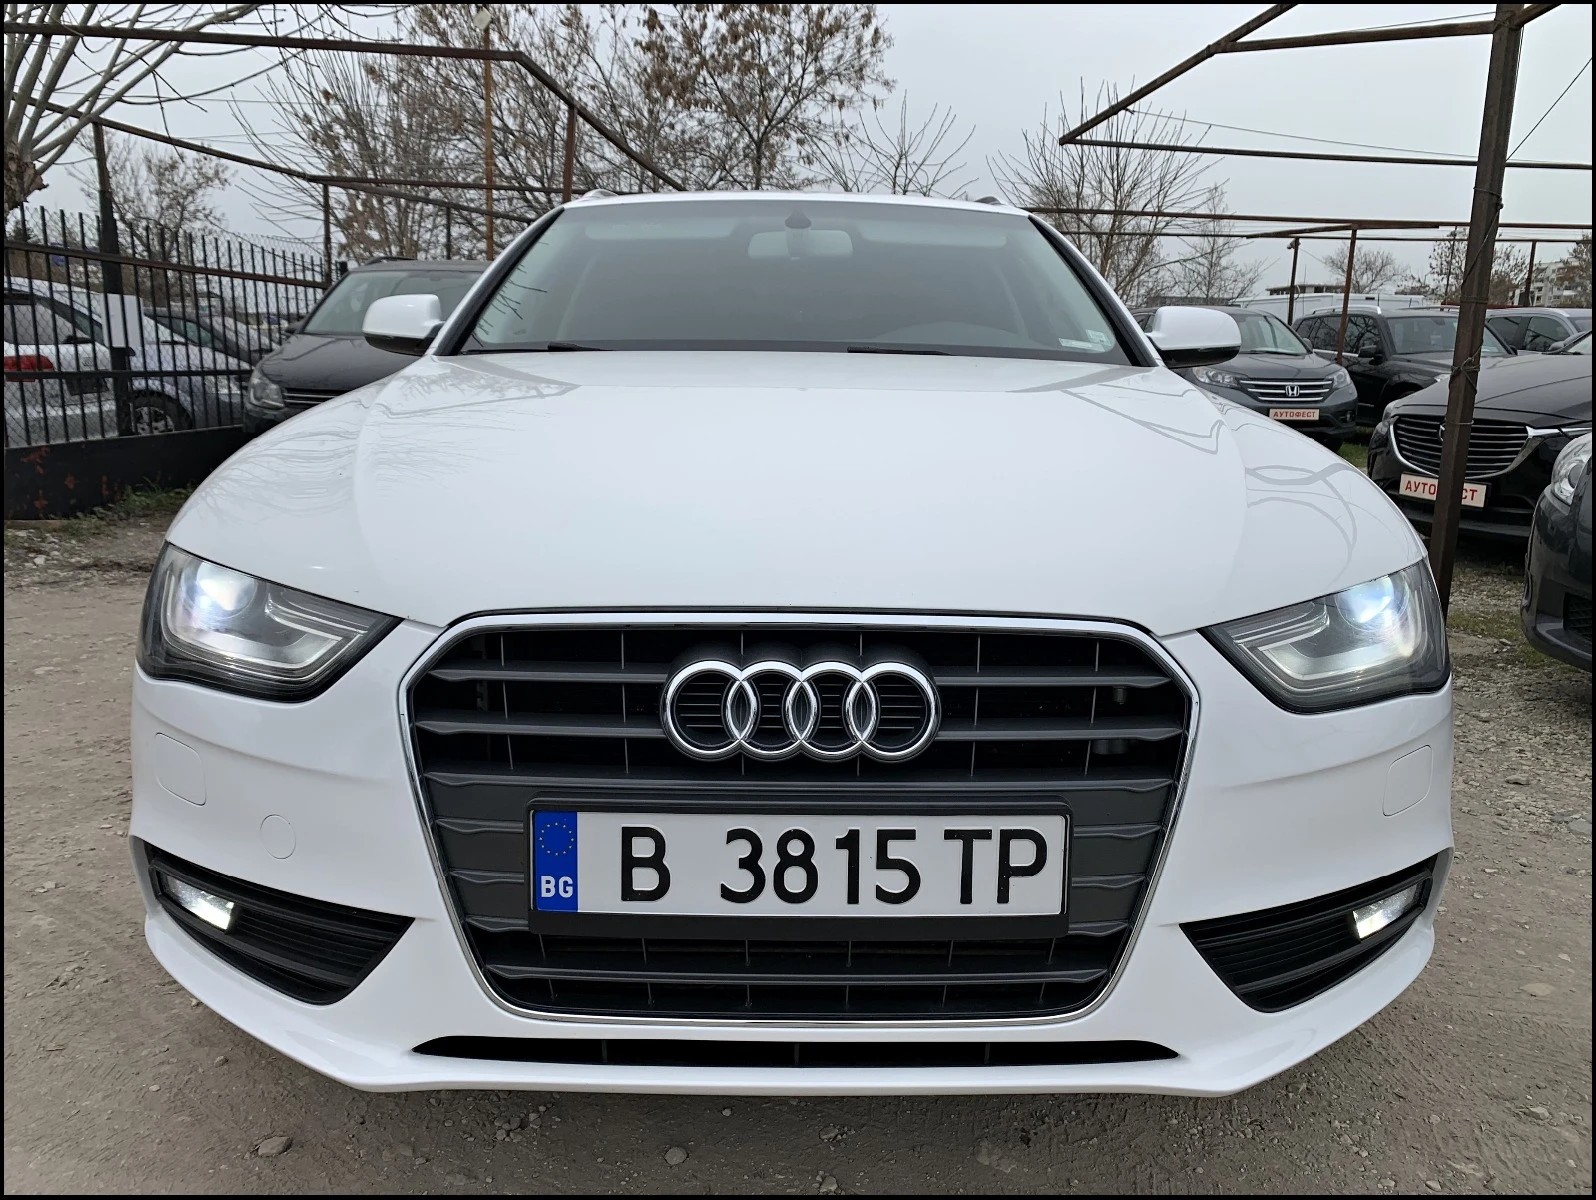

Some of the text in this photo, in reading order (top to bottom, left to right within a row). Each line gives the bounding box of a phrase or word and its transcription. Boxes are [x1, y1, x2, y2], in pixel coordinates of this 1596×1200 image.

[1404, 480, 1478, 501] АУТОСТ
[620, 826, 1048, 905] B 3815 TP
[541, 875, 574, 898] BG
